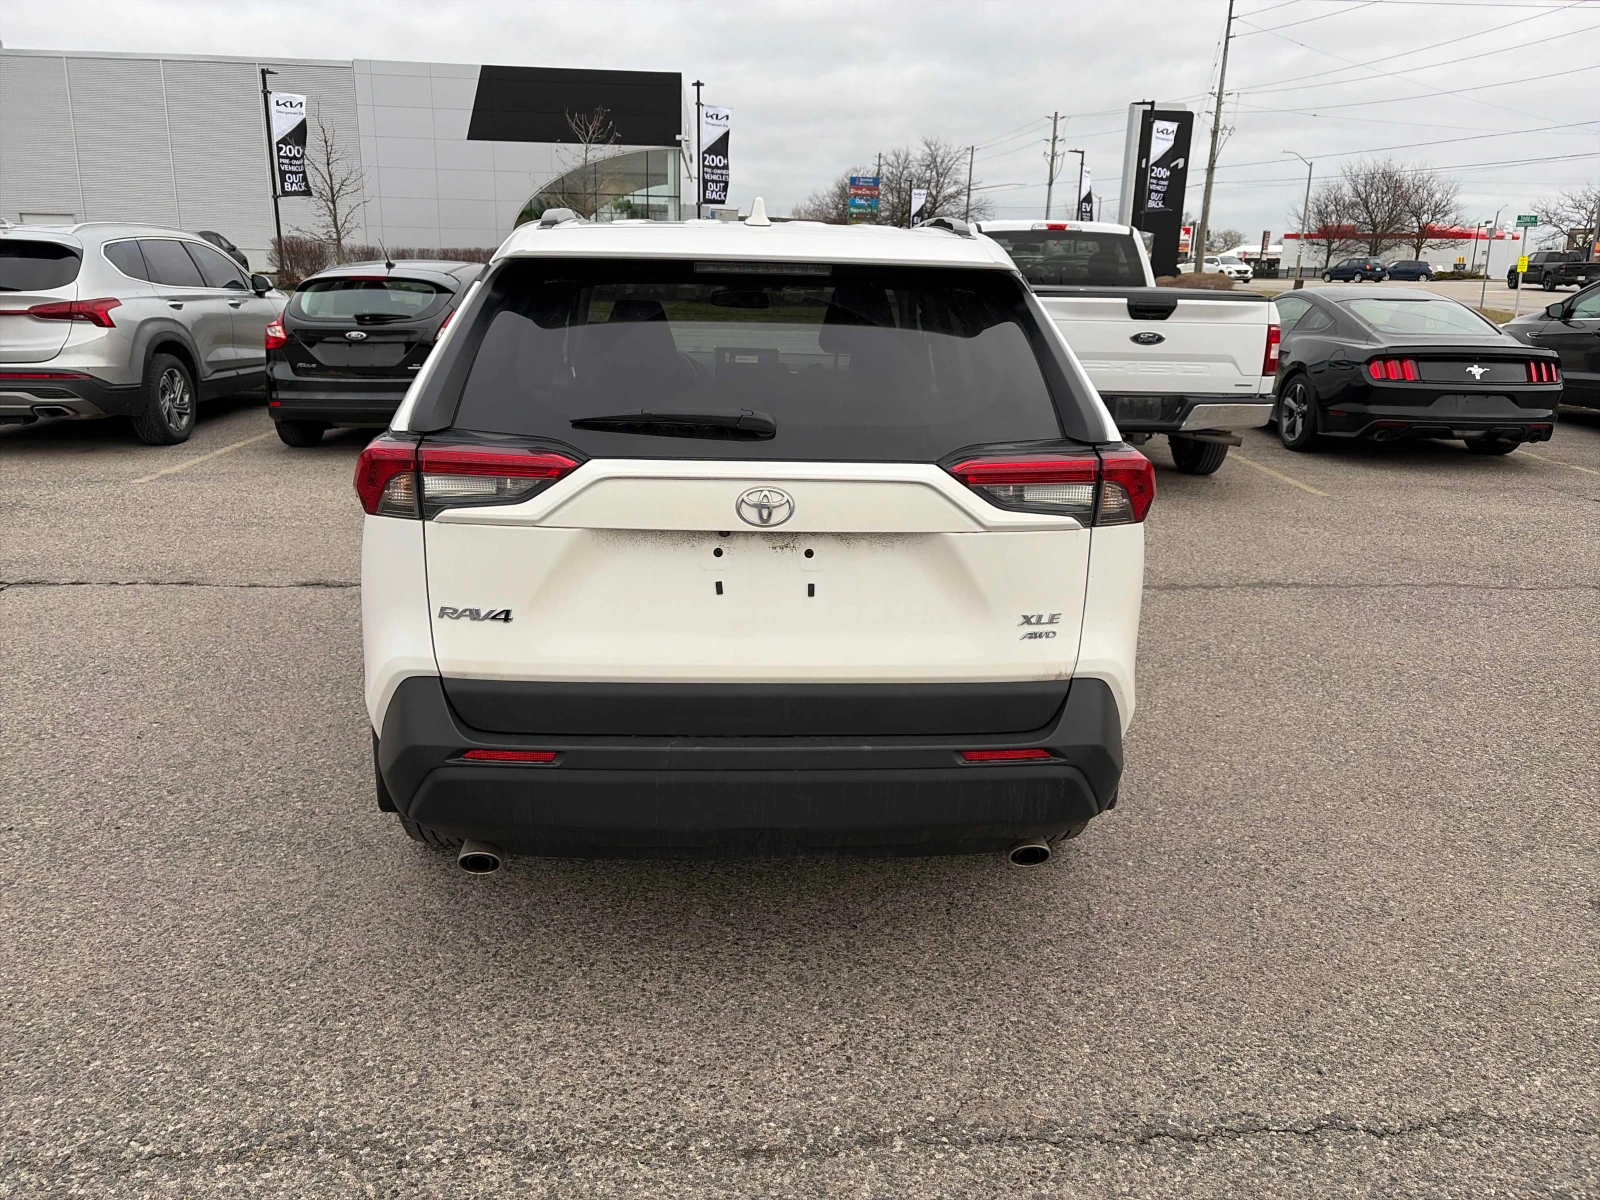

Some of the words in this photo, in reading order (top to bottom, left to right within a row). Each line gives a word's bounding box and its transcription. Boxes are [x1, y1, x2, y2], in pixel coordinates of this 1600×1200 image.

[276, 99, 303, 108] KIA
[706, 111, 729, 120] KIA
[704, 154, 727, 166] 200+
[1151, 166, 1170, 178] 200+
[286, 174, 303, 182] OUT
[284, 182, 307, 191] BACK
[708, 182, 725, 191] OUT
[706, 190, 726, 200] BACK
[1151, 192, 1163, 200] OUT
[1082, 203, 1091, 211] EV
[1148, 200, 1164, 208] BACK
[438, 606, 514, 623] RAV4
[1017, 613, 1062, 626] XLE
[1019, 631, 1057, 640] AWD
